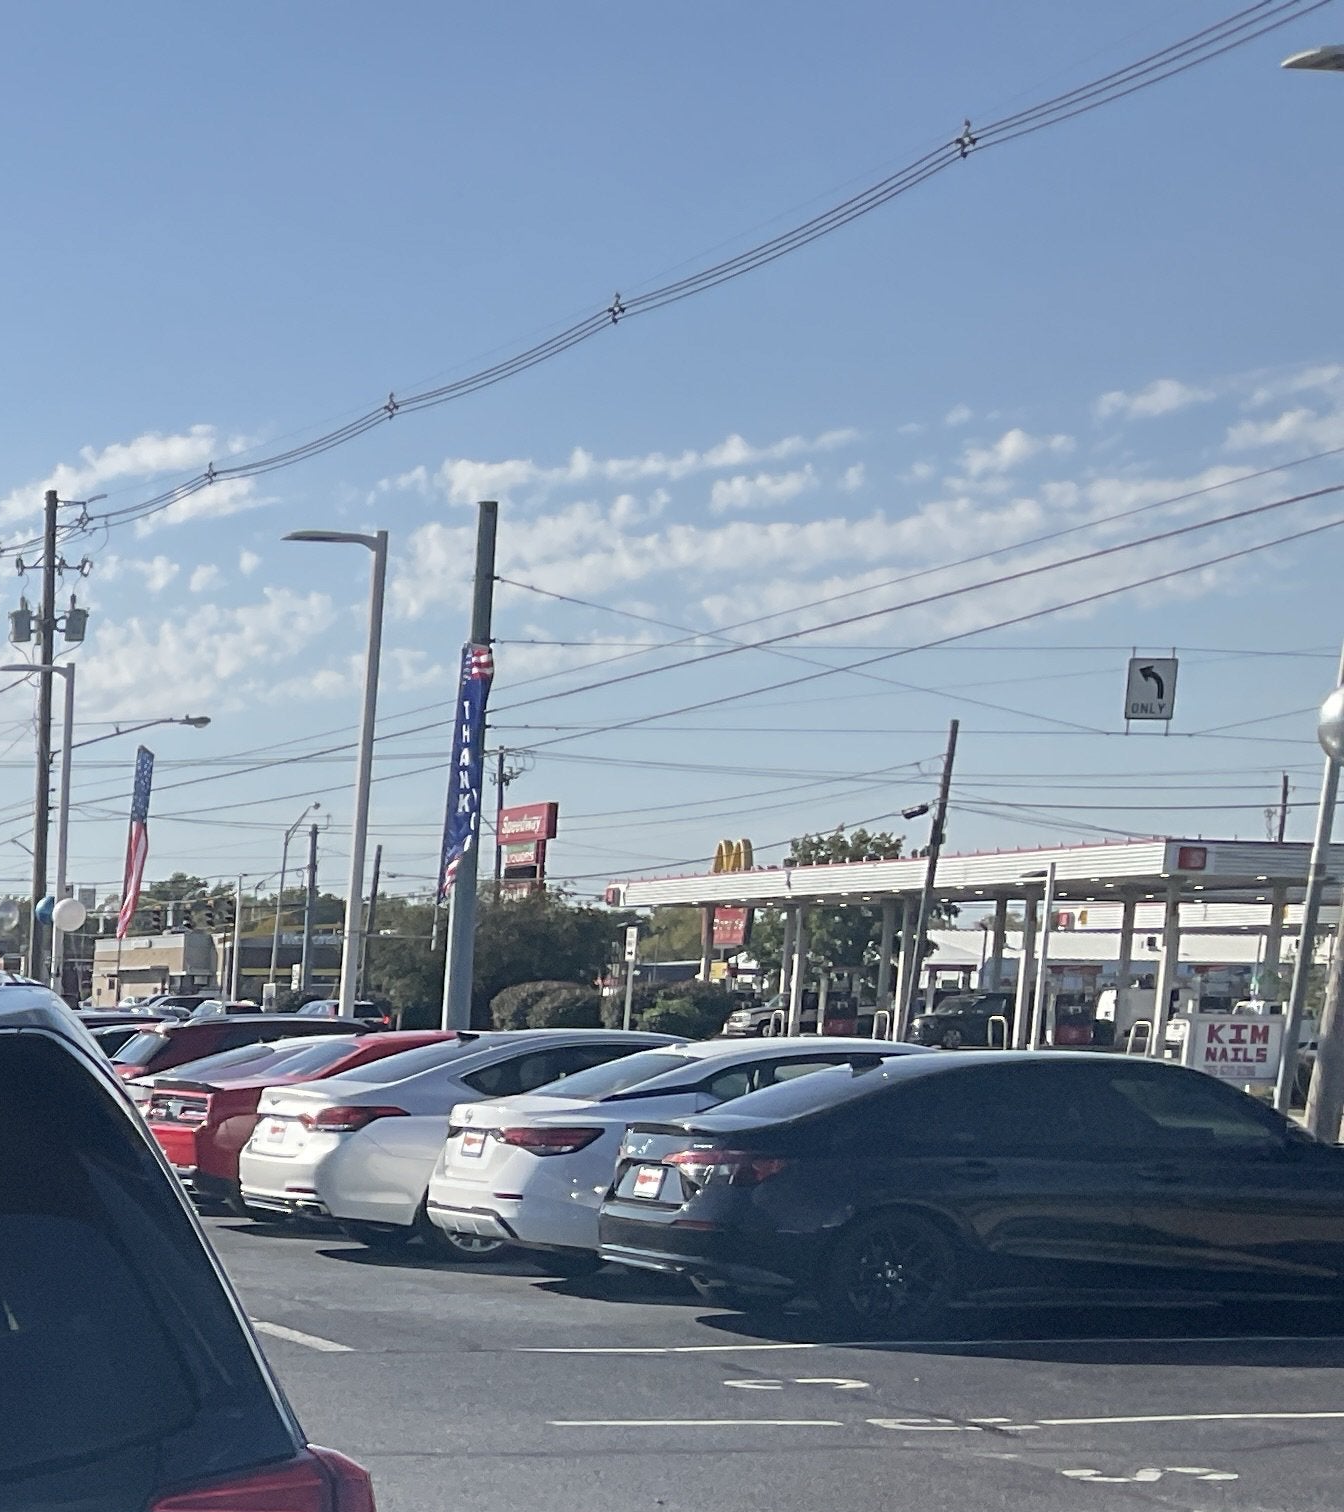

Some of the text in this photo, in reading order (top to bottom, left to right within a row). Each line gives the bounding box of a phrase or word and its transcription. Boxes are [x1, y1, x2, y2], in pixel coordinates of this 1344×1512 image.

[1130, 702, 1167, 715] ONLY
[456, 699, 472, 813] THANK
[1207, 1023, 1270, 1045] KIM
[1205, 1046, 1268, 1063] NAILS
